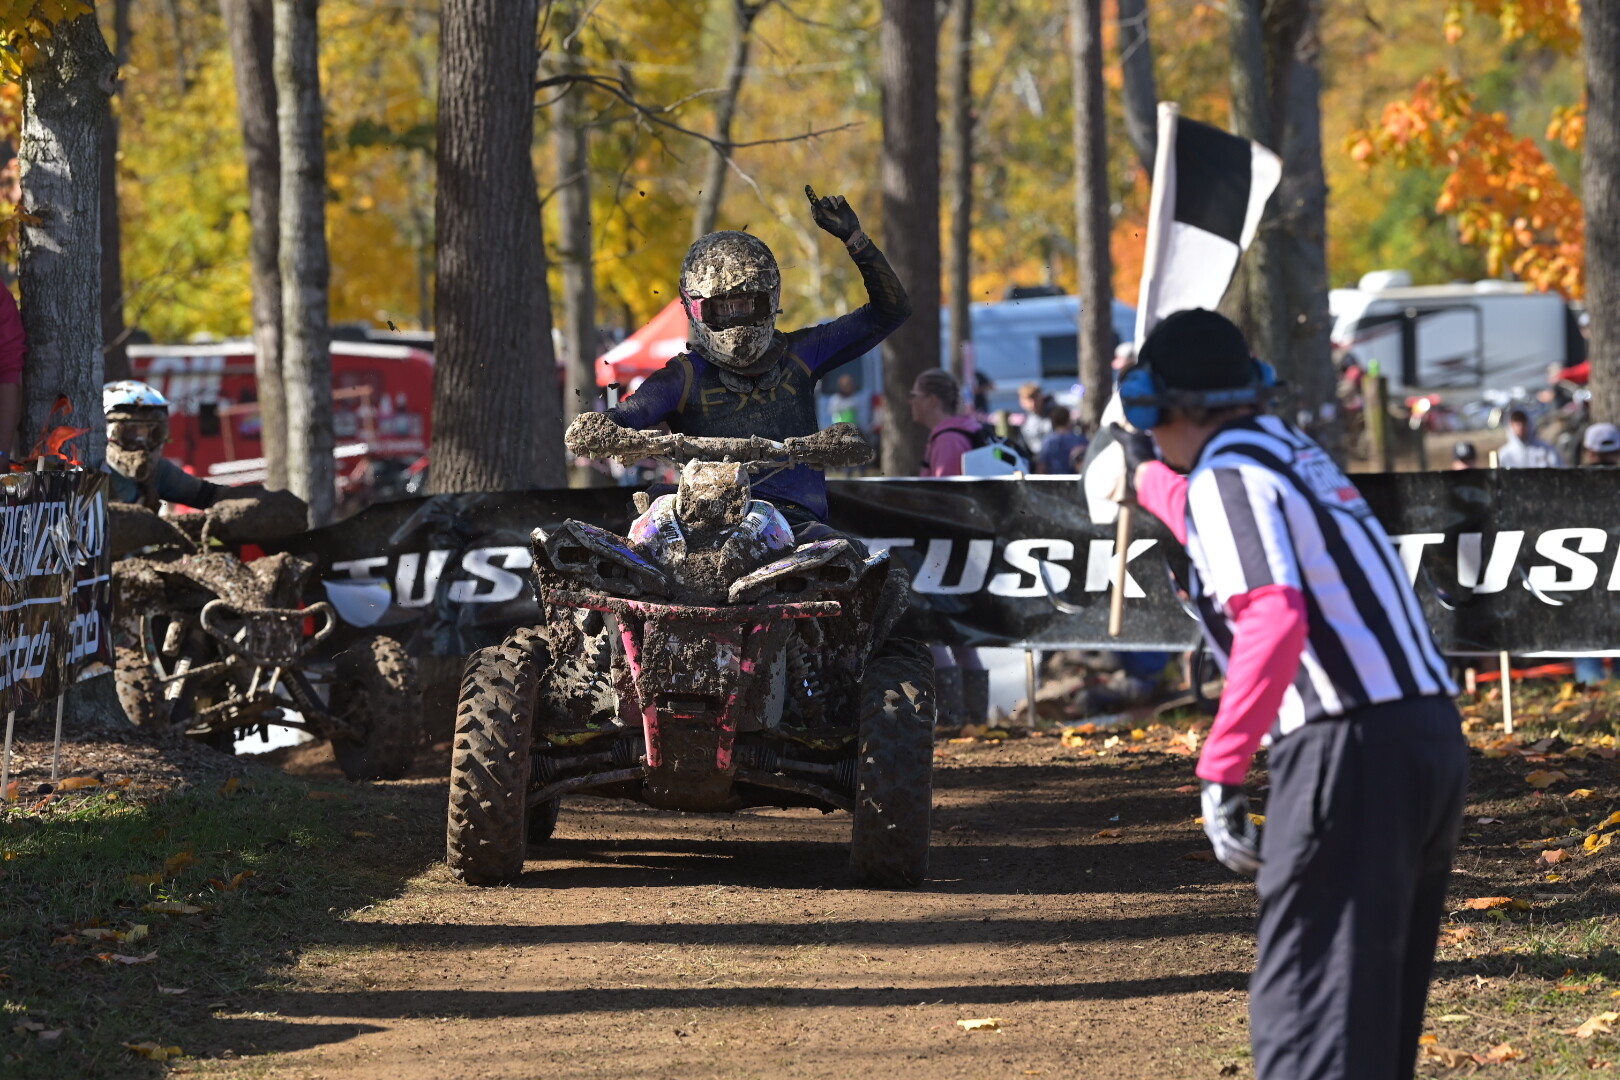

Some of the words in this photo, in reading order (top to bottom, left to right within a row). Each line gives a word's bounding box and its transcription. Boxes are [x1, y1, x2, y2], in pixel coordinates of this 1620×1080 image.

[332, 546, 533, 608] TUS
[864, 538, 1158, 598] TUSK
[1388, 527, 1620, 594] TUS
